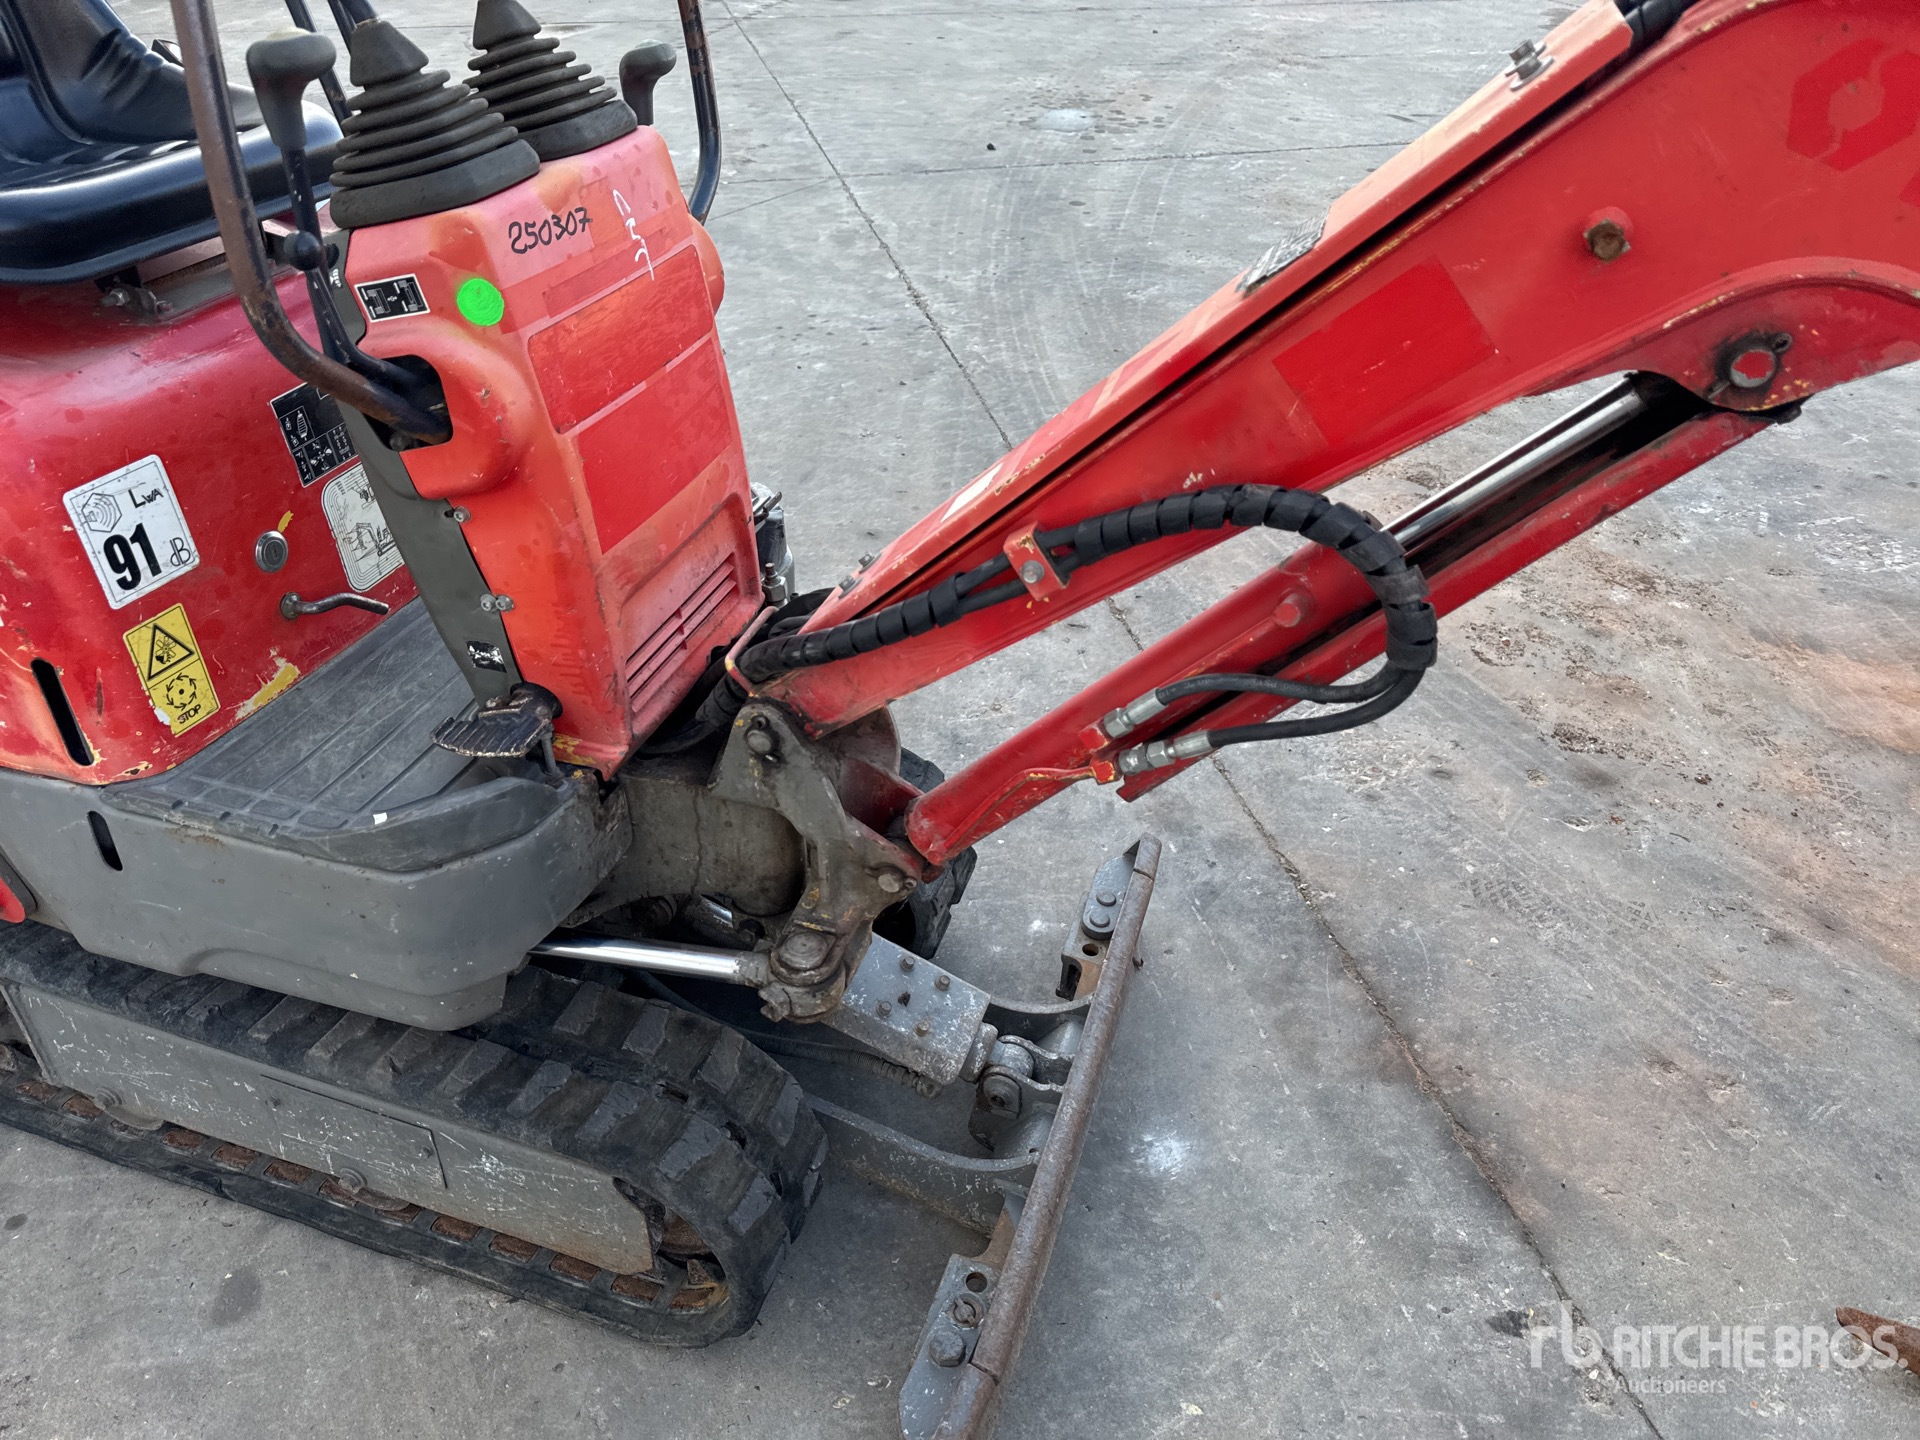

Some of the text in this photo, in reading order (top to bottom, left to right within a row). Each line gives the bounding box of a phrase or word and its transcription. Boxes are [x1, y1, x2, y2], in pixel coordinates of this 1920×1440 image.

[508, 207, 592, 254] 250307
[103, 522, 191, 591] 91 dB
[177, 704, 201, 724] STOP
